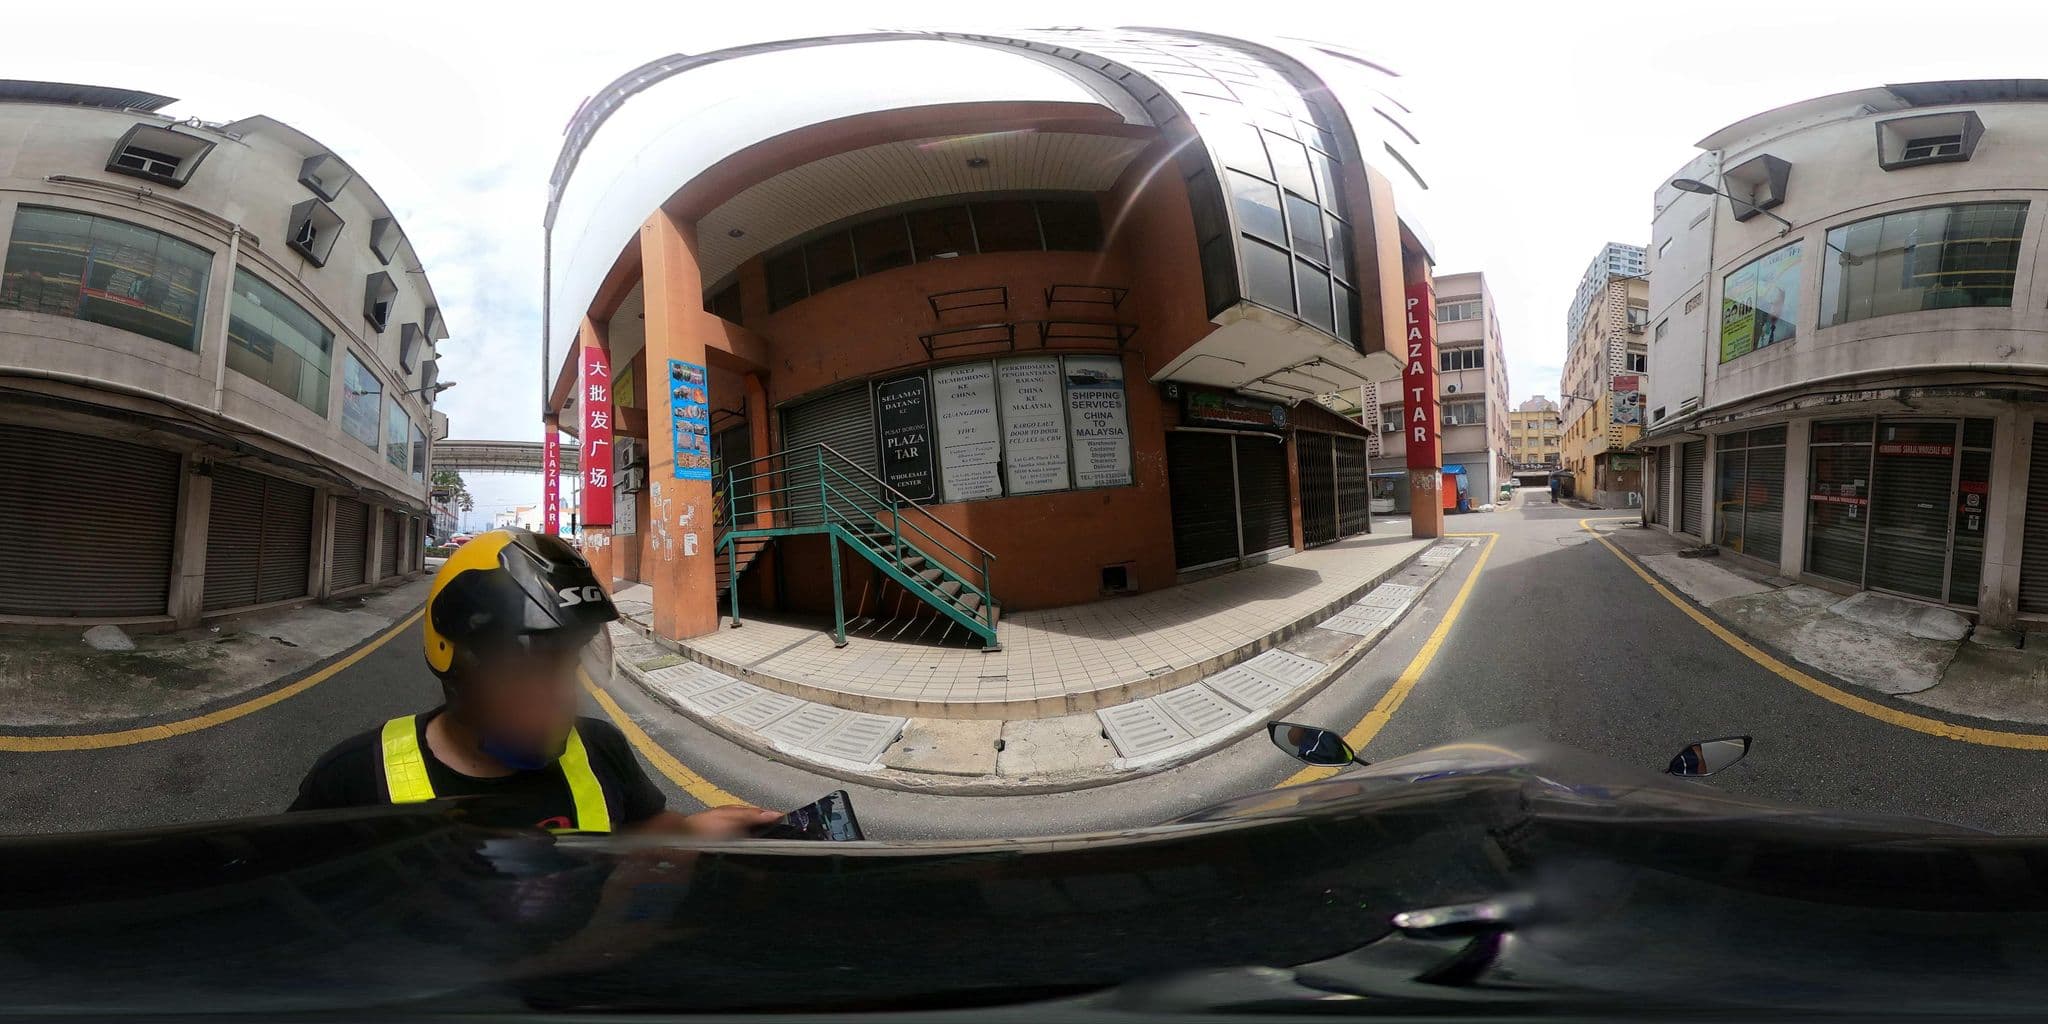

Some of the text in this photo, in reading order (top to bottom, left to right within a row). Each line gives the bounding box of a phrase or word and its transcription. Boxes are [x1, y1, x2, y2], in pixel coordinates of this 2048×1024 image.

[1407, 298, 1426, 442] PLAZA TAR
[882, 390, 921, 402] SELAMAT
[1072, 392, 1120, 400] SHIPPING
[885, 399, 921, 410] DATANG
[1072, 401, 1122, 409] SERVICES
[590, 361, 609, 488] 大批发广场
[1076, 428, 1124, 436] MALAYSIA
[888, 434, 925, 448] PLAZA
[895, 447, 919, 460] TAR
[890, 471, 928, 480] WHOLESALE
